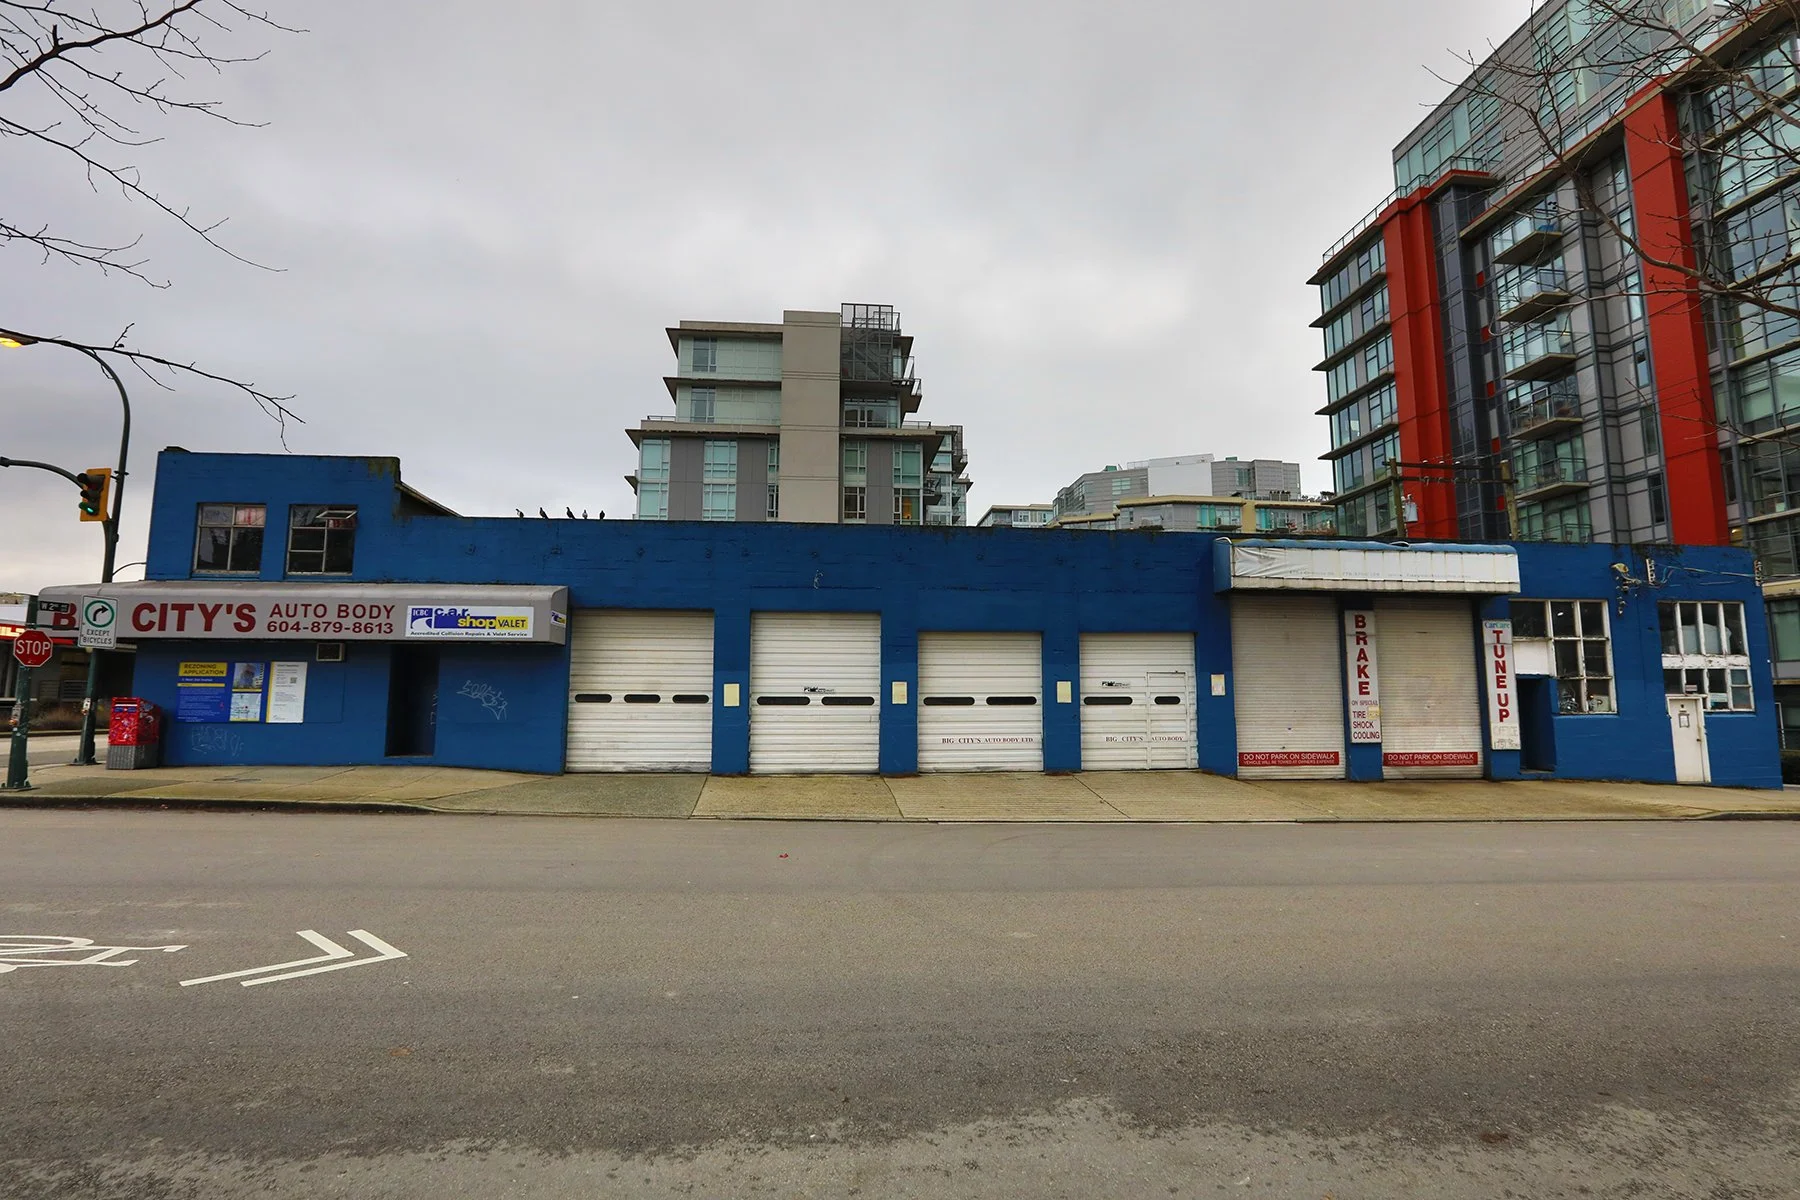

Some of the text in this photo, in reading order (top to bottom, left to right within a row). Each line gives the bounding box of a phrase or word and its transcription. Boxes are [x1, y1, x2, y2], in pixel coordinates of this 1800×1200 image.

[132, 602, 257, 632] CITY'S
[269, 603, 395, 620] AUTO BODY
[412, 608, 429, 617] ICBC
[266, 620, 394, 634] 604-879-8613
[457, 615, 497, 631] shop
[497, 618, 526, 629] VALET
[86, 629, 110, 638] EXCEPT
[82, 636, 112, 645] BICYCLES
[16, 640, 50, 656] STOP
[1354, 614, 1371, 696] BRAKE
[1492, 629, 1508, 689] TUNE
[182, 668, 225, 676] APPLICATION
[1497, 693, 1510, 723] UP
[1352, 710, 1367, 719] TIRE
[1352, 720, 1375, 729] SHOCK
[1353, 731, 1380, 740] COOLING
[1388, 753, 1398, 761] DO
